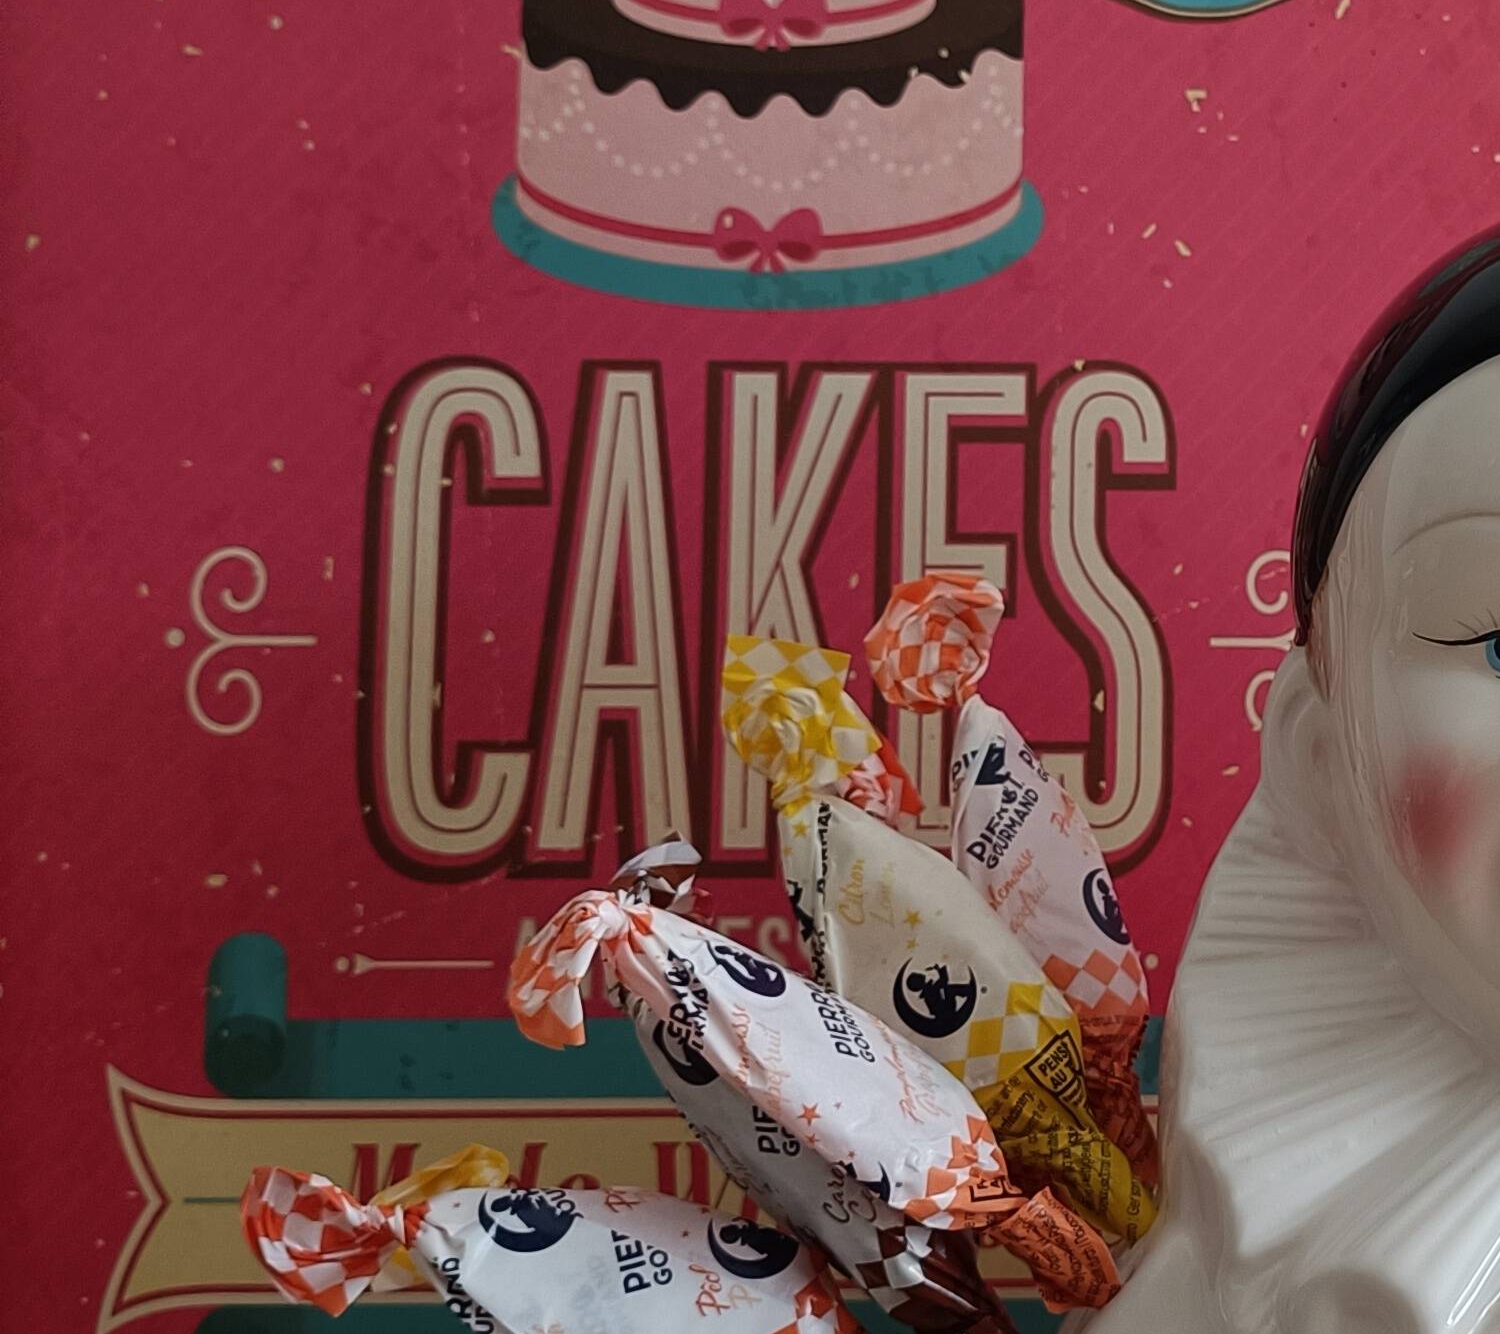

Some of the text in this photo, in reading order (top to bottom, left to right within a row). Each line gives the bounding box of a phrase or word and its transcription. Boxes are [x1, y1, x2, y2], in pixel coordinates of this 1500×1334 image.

[363, 359, 1177, 873] CAKES
[838, 858, 867, 926] Citron
[811, 981, 858, 1058] PIERR
